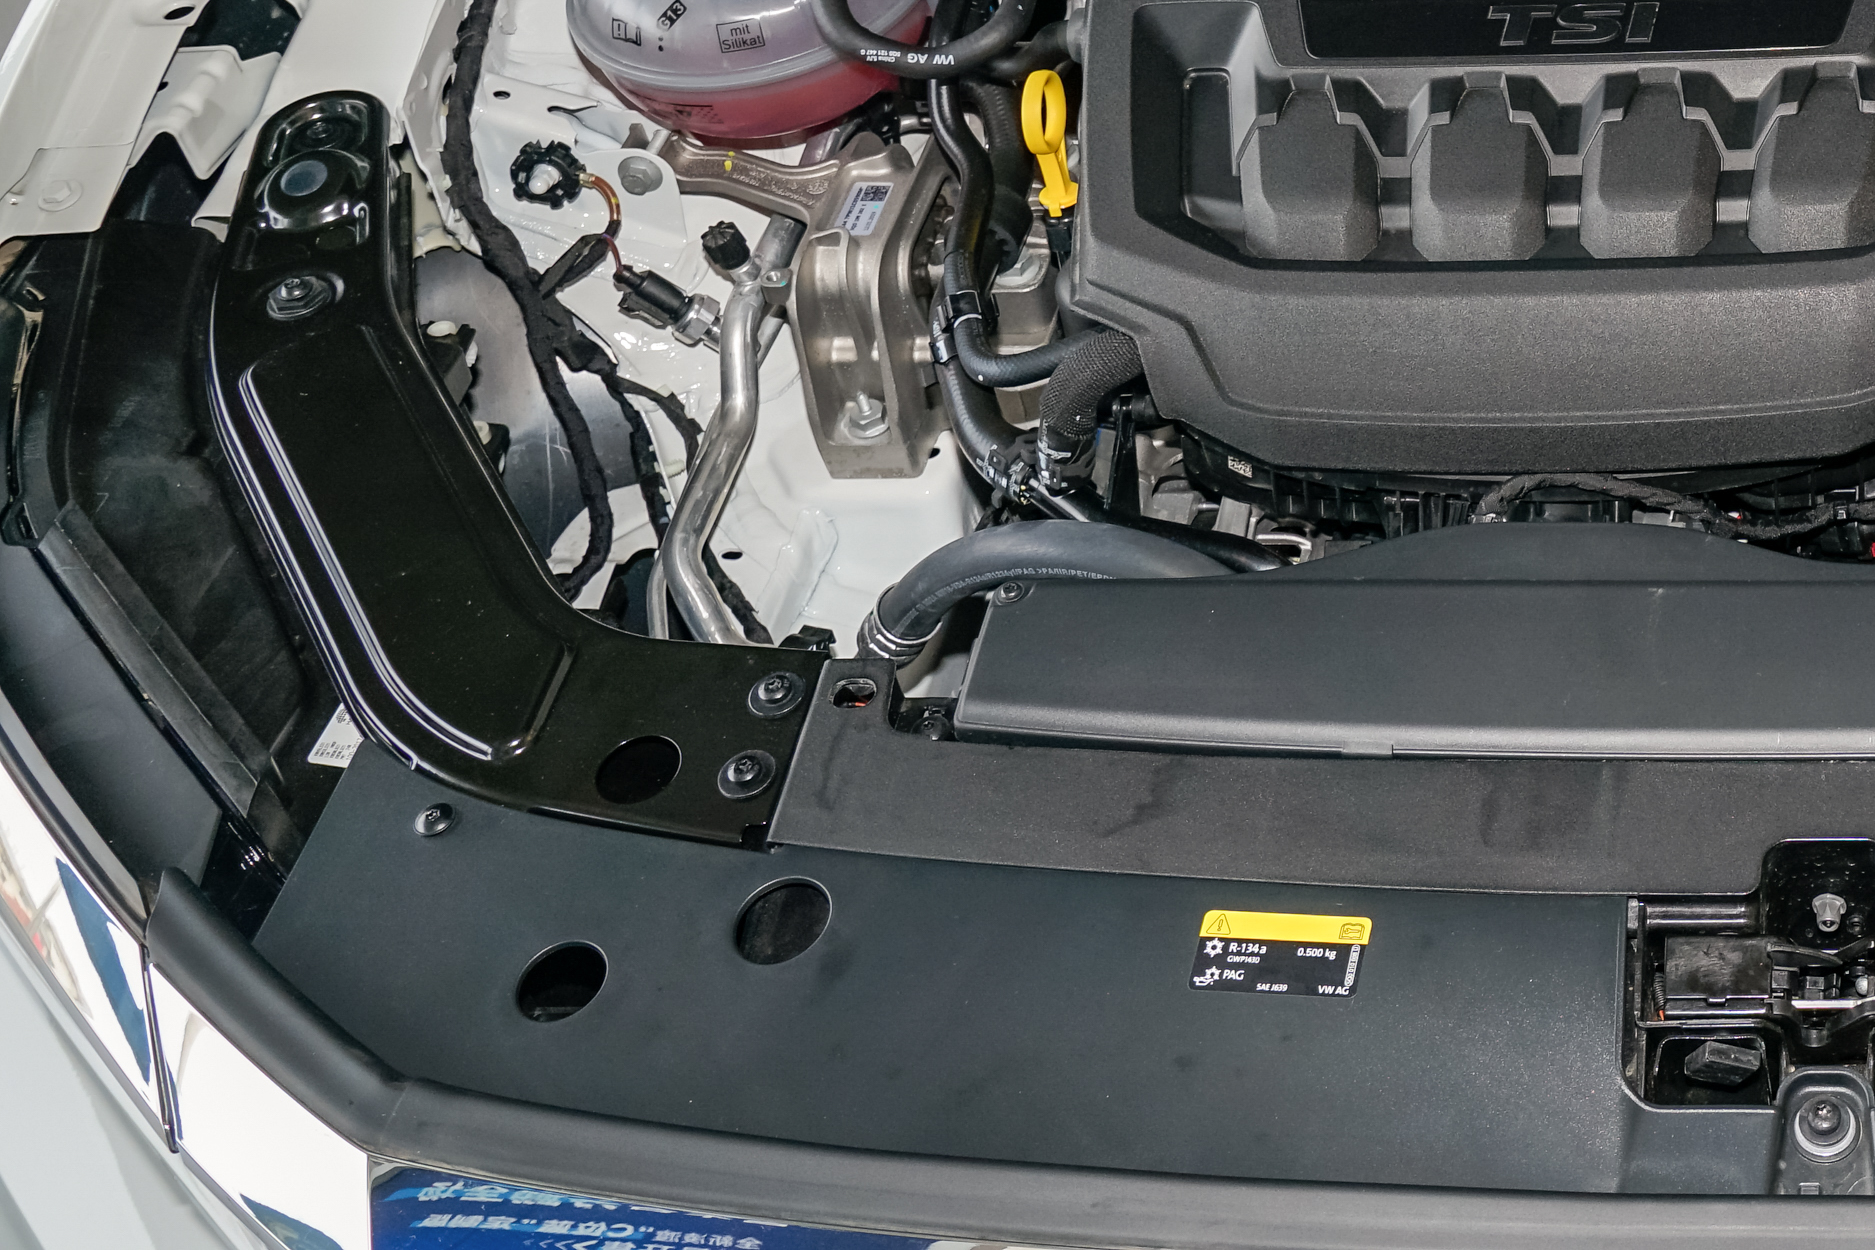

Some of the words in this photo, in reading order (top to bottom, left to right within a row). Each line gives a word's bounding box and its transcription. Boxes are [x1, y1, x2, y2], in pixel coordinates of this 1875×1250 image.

[659, 3, 685, 29] G13
[730, 24, 750, 37] mit
[1487, 2, 1660, 46] TSI
[723, 35, 762, 50] Silikat
[907, 53, 928, 63] AG
[933, 54, 954, 65] VW
[1297, 947, 1324, 958] 0.500
[1325, 948, 1337, 961] kg
[1222, 969, 1245, 981] PAG
[1256, 982, 1270, 992] SAE
[1271, 983, 1288, 992] J639
[1318, 984, 1333, 995] VW
[1333, 985, 1350, 995] AG
